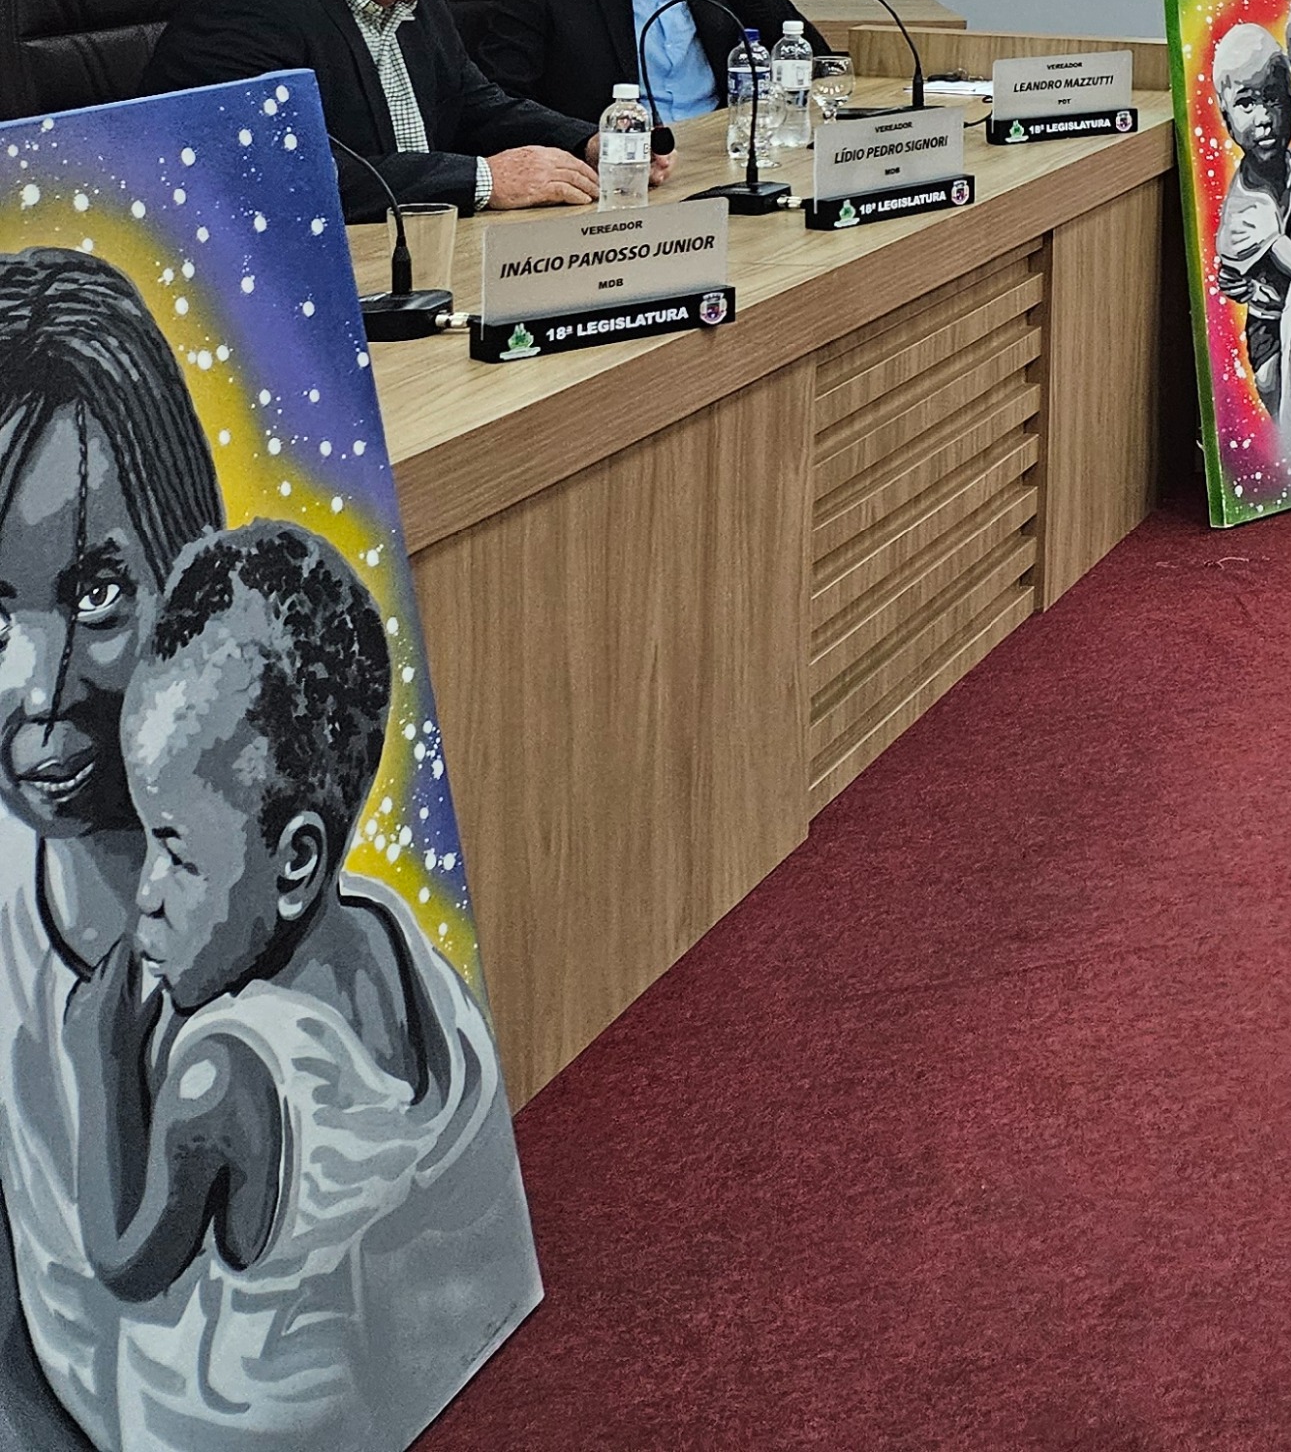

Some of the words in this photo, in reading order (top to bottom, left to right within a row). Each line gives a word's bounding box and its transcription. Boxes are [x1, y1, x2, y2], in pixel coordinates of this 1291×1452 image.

[1047, 61, 1083, 70] VEREADOR
[1013, 79, 1062, 93] LEANDRO
[1063, 75, 1114, 89] MAZZUTTI
[875, 121, 913, 133] VEREADOR
[1046, 118, 1111, 133] LEGISLATURA
[834, 148, 864, 164] LÍDIO
[866, 141, 904, 159] PEDRO
[904, 135, 948, 153] SIGNORI
[878, 190, 946, 212] LEGISLATURA
[581, 220, 643, 236] VEREADOR
[499, 254, 564, 279] INÁCIO
[567, 244, 651, 269] PANOSSO
[653, 235, 715, 257] JUNIOR
[598, 278, 624, 290] MDB
[545, 325, 574, 341] 18ª
[577, 306, 689, 337] LEGISLATURA
